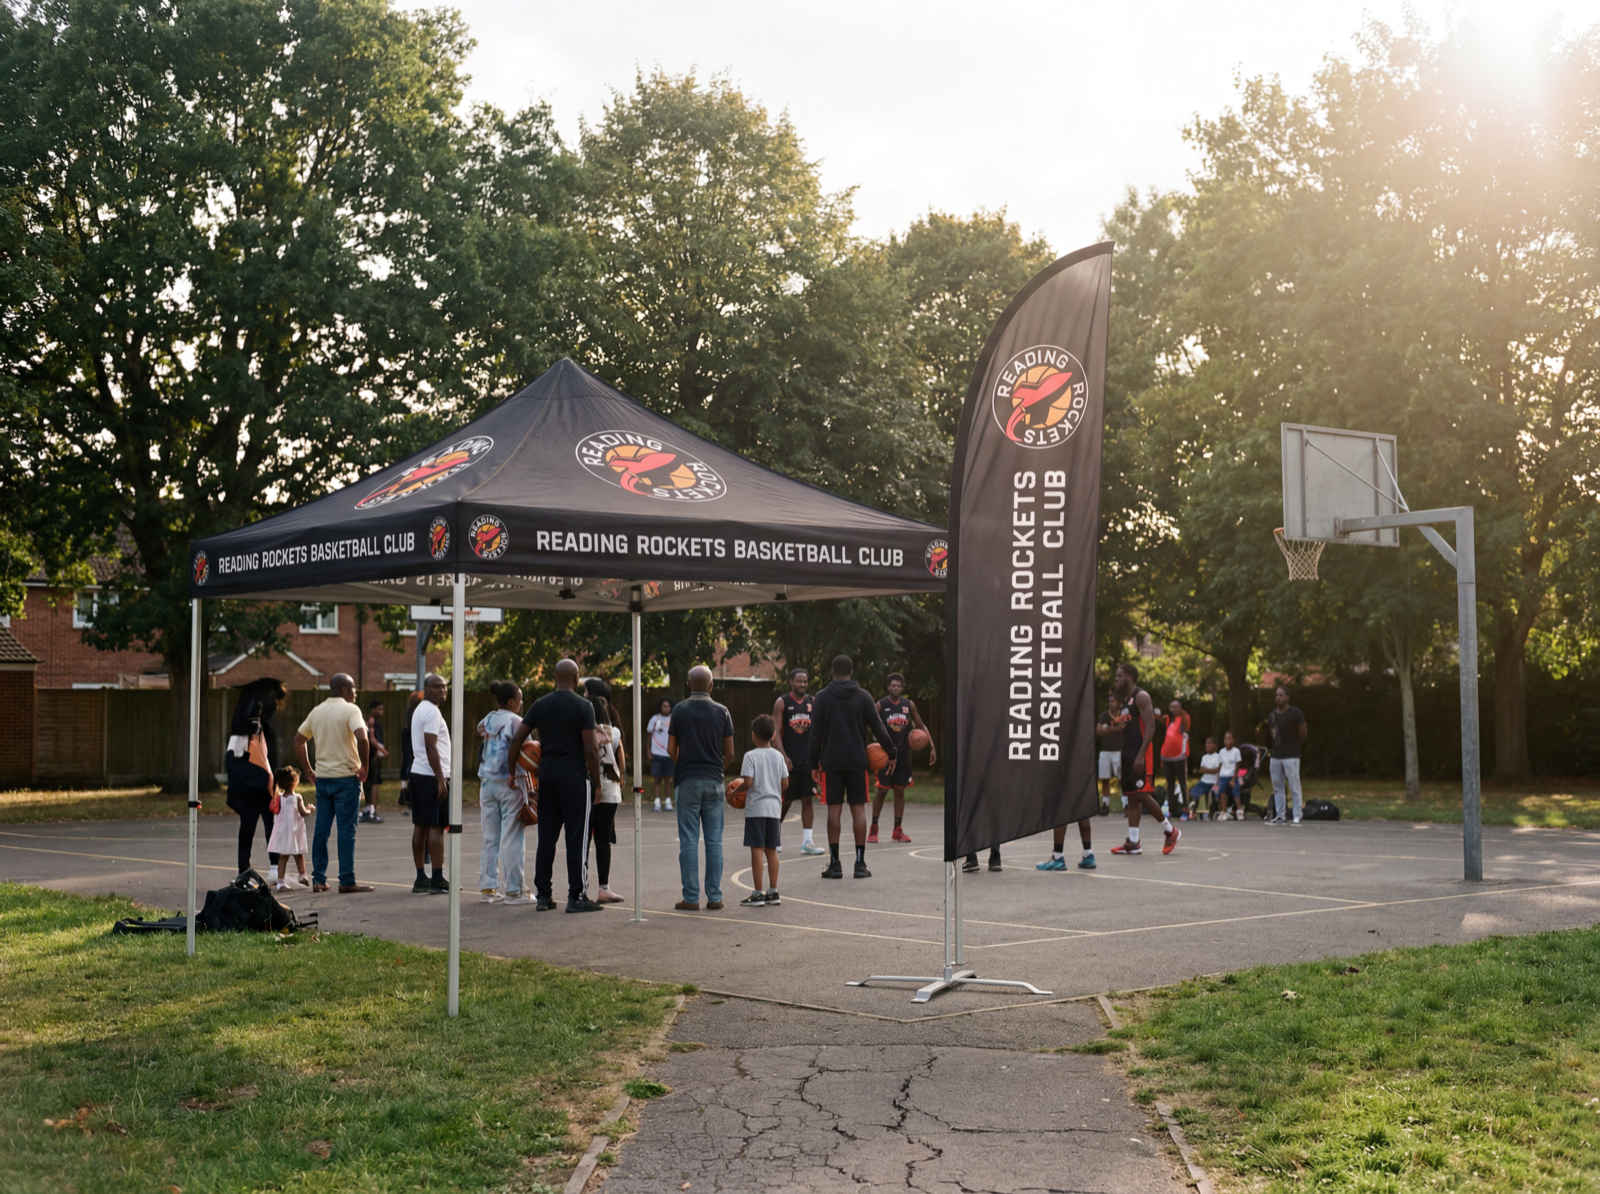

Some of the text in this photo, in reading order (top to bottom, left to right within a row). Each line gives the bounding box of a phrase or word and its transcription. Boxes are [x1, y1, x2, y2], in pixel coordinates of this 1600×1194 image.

[997, 349, 1084, 445] READING ROCKETS
[582, 433, 721, 500] READING ROCKETS
[218, 554, 259, 575] READING
[262, 546, 308, 569] ROCKETS
[311, 537, 381, 562] BASKETBALL
[384, 532, 415, 554] CLUB
[536, 530, 904, 567] READING ROCKETS BASKETBALL CLUB
[1008, 470, 1037, 761] READING ROCKETS
[1039, 470, 1066, 761] BASKETBALL CLUB
